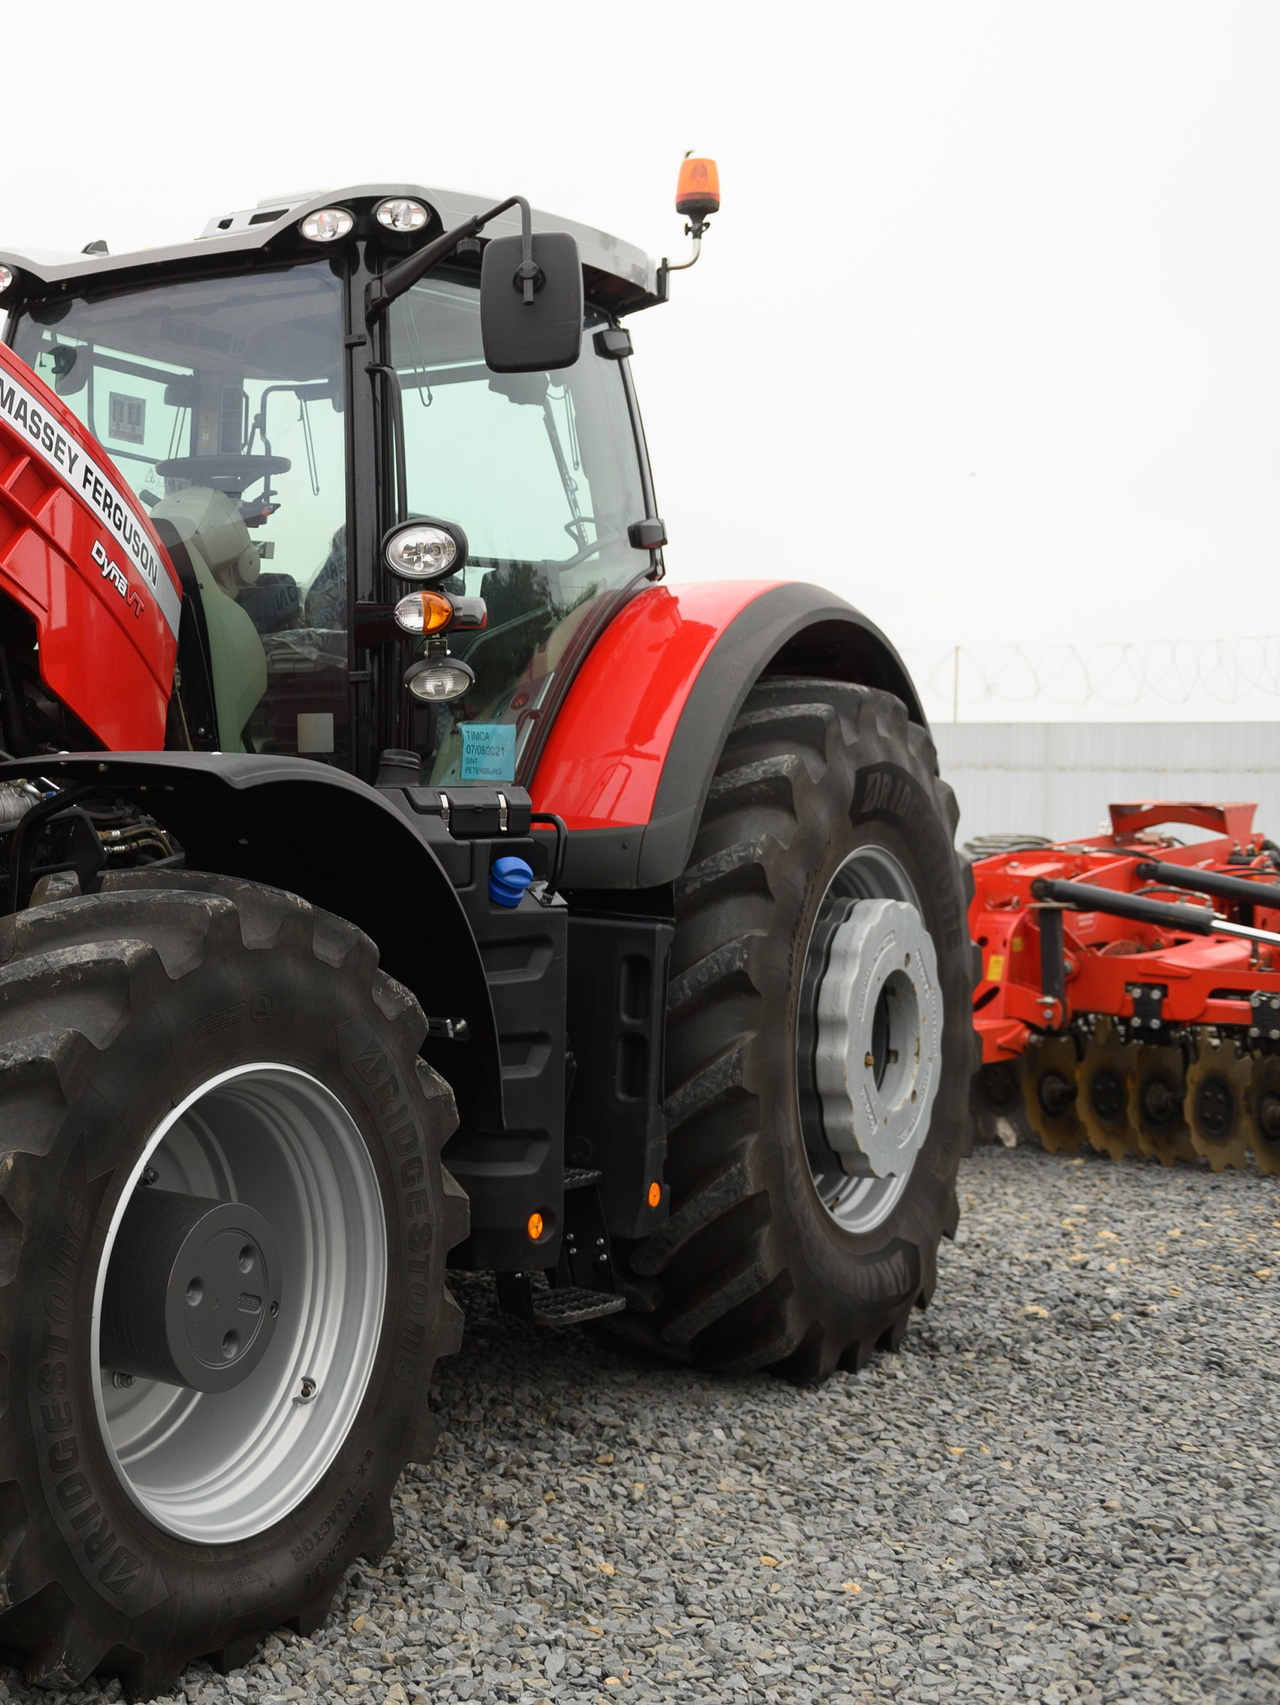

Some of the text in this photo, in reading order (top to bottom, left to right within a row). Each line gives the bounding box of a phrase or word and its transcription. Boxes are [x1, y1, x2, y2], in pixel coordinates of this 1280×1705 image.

[82, 464, 160, 590] FERGUSON
[465, 730, 490, 742] TIMCA
[465, 744, 505, 757] 07/08/2021
[464, 766, 503, 776] PETERSBURG
[351, 1039, 433, 1388] BRIDGESTONE
[38, 1192, 144, 1597] BRIDGESTONE
